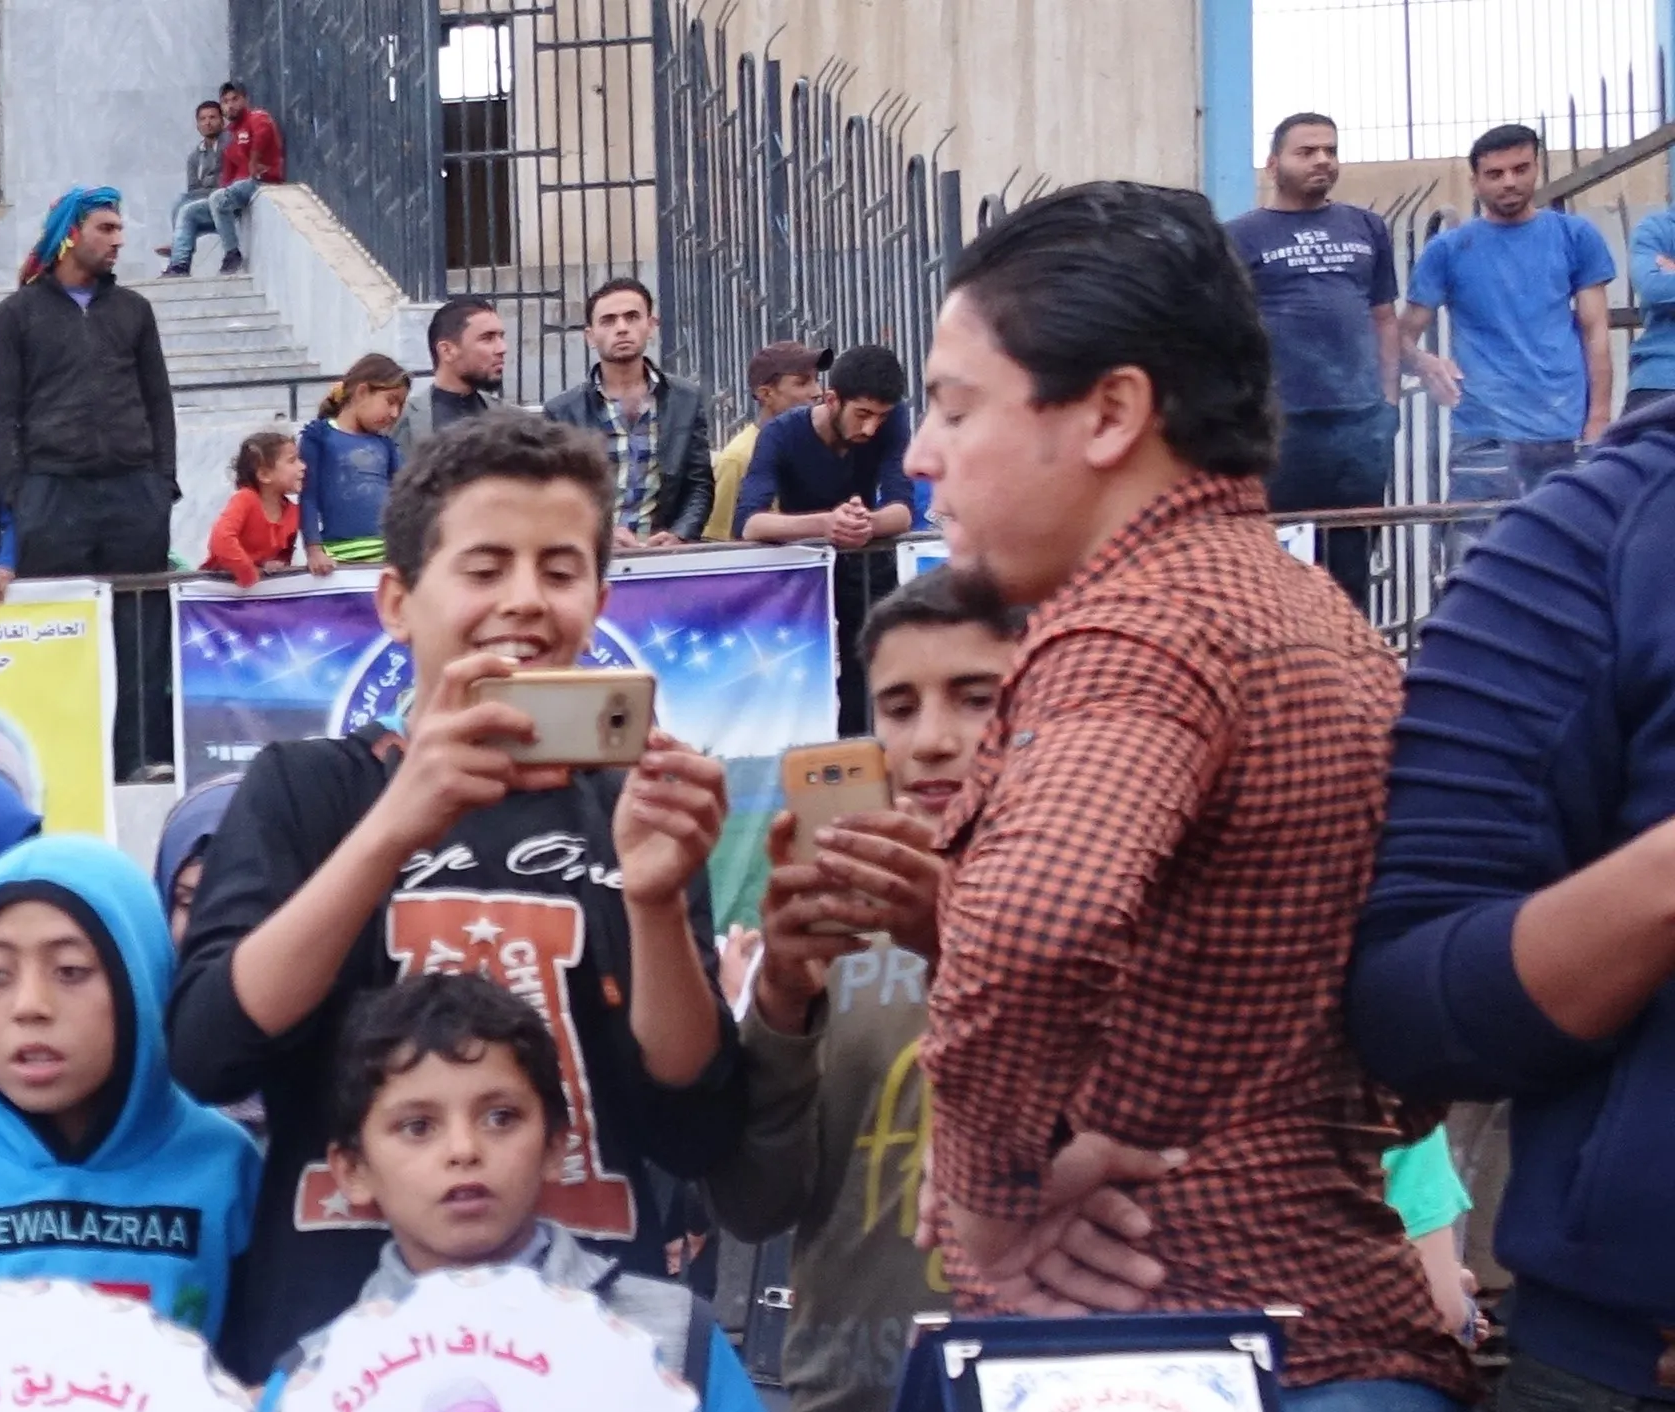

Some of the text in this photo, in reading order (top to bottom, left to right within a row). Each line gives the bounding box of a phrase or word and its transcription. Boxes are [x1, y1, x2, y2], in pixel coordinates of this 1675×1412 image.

[33, 621, 85, 642] الحاضر
[349, 651, 407, 733] في الرق
[399, 844, 479, 889] op
[446, 1326, 552, 1377] هداف
